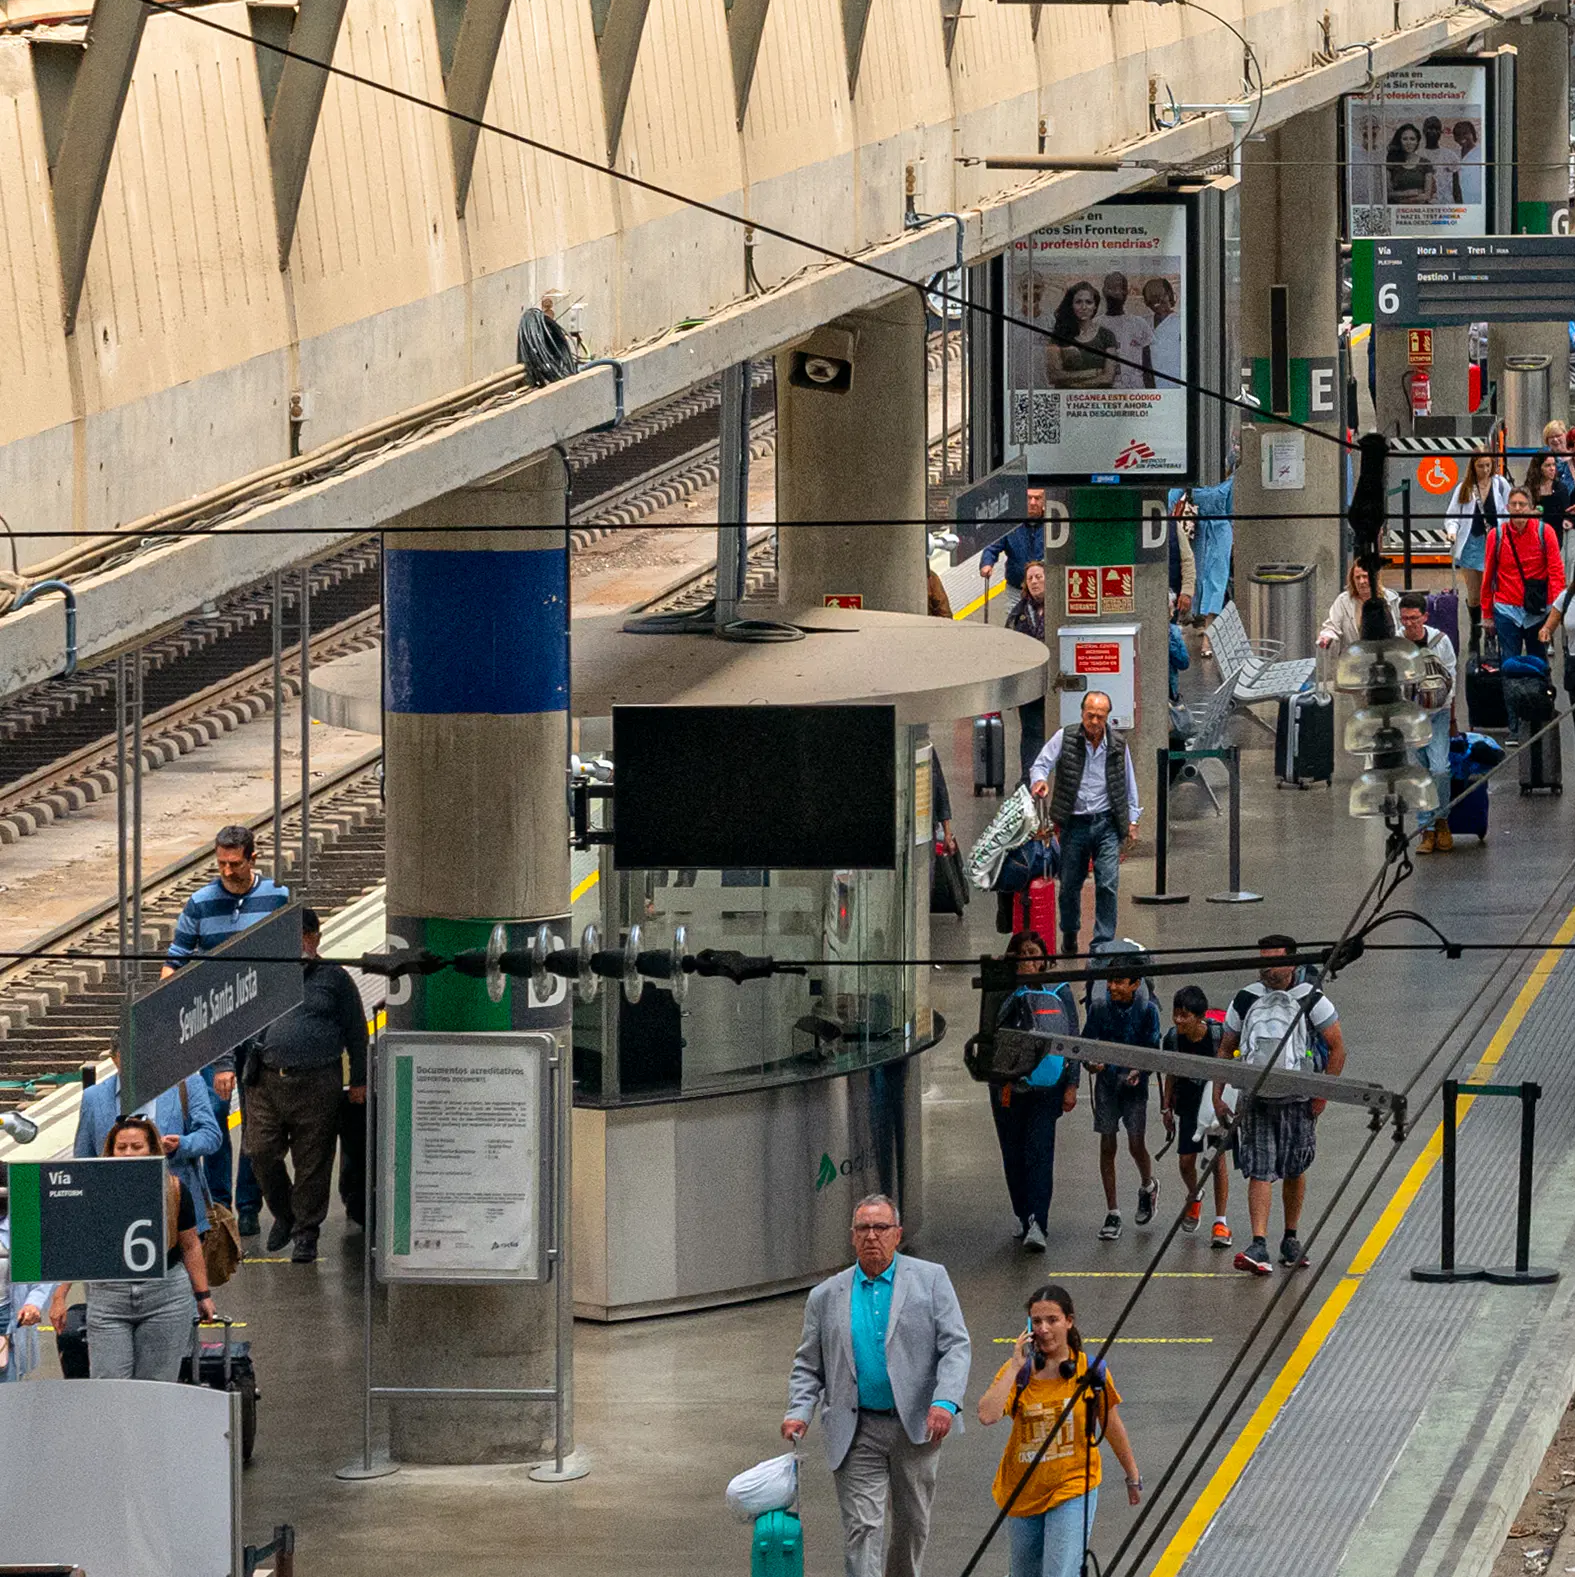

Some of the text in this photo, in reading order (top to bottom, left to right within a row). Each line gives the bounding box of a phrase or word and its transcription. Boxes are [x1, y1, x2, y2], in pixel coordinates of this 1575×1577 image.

[1087, 213, 1103, 221] en
[1551, 208, 1569, 235] G
[1063, 225, 1082, 235] Sin
[1085, 225, 1148, 236] Fronteras,
[1041, 239, 1099, 251] profesión
[1102, 238, 1160, 249] tendrías?
[1378, 246, 1391, 255] Vía
[1417, 246, 1436, 255] Hora
[1467, 246, 1486, 254] Tren
[1417, 272, 1449, 281] Destino
[1378, 283, 1400, 314] 6
[1312, 369, 1333, 411] E
[1045, 500, 1069, 548] D
[1142, 500, 1167, 548] D
[179, 967, 258, 1044] Sevilla Santa Justa
[416, 1066, 524, 1075] Documentos acreditativos
[48, 1171, 71, 1185] Vía
[49, 1190, 83, 1198] PLATFORM
[123, 1219, 157, 1272] 6
